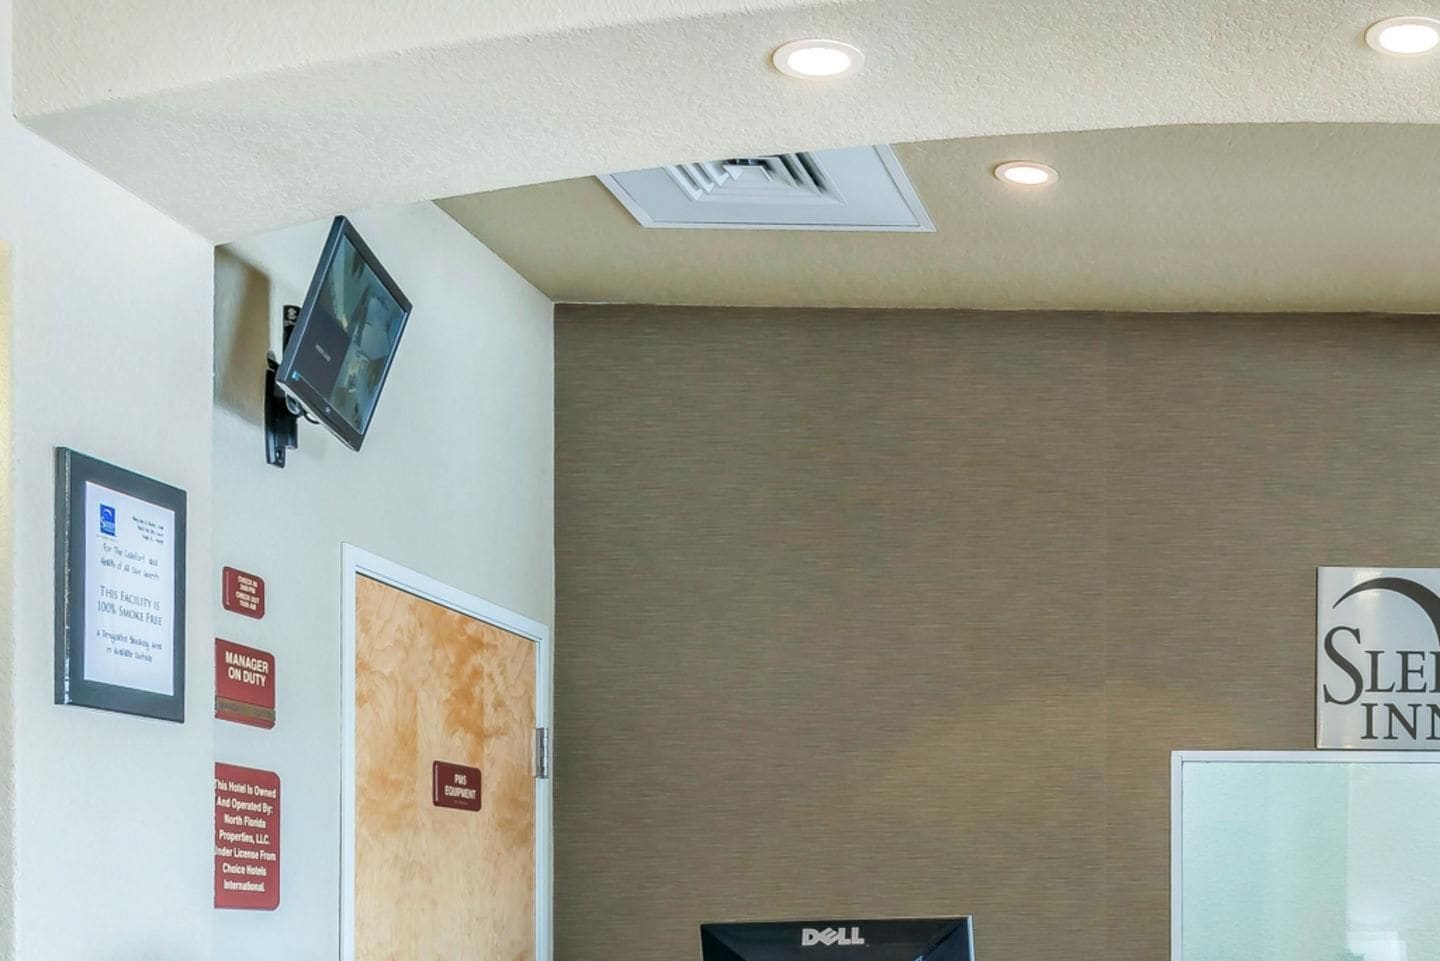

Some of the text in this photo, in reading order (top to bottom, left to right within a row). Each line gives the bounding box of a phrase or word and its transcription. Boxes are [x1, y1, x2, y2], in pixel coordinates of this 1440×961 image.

[100, 585, 118, 600] THIS
[120, 590, 153, 609] FACILITY
[97, 600, 162, 626] 100% SMOKE FREE
[225, 651, 269, 674] MANAGER
[228, 666, 267, 687] ON DUTY
[229, 781, 247, 794] Hotel
[254, 785, 276, 799] Owned
[445, 785, 477, 800] EQUIPMENT
[216, 795, 231, 808] And
[231, 798, 261, 812] Operated
[224, 813, 266, 829] North Florida
[219, 829, 255, 845] Properties,
[233, 847, 259, 860] License
[260, 850, 277, 861] From
[222, 862, 267, 877] Choice Hotels
[801, 926, 865, 947] DELL
